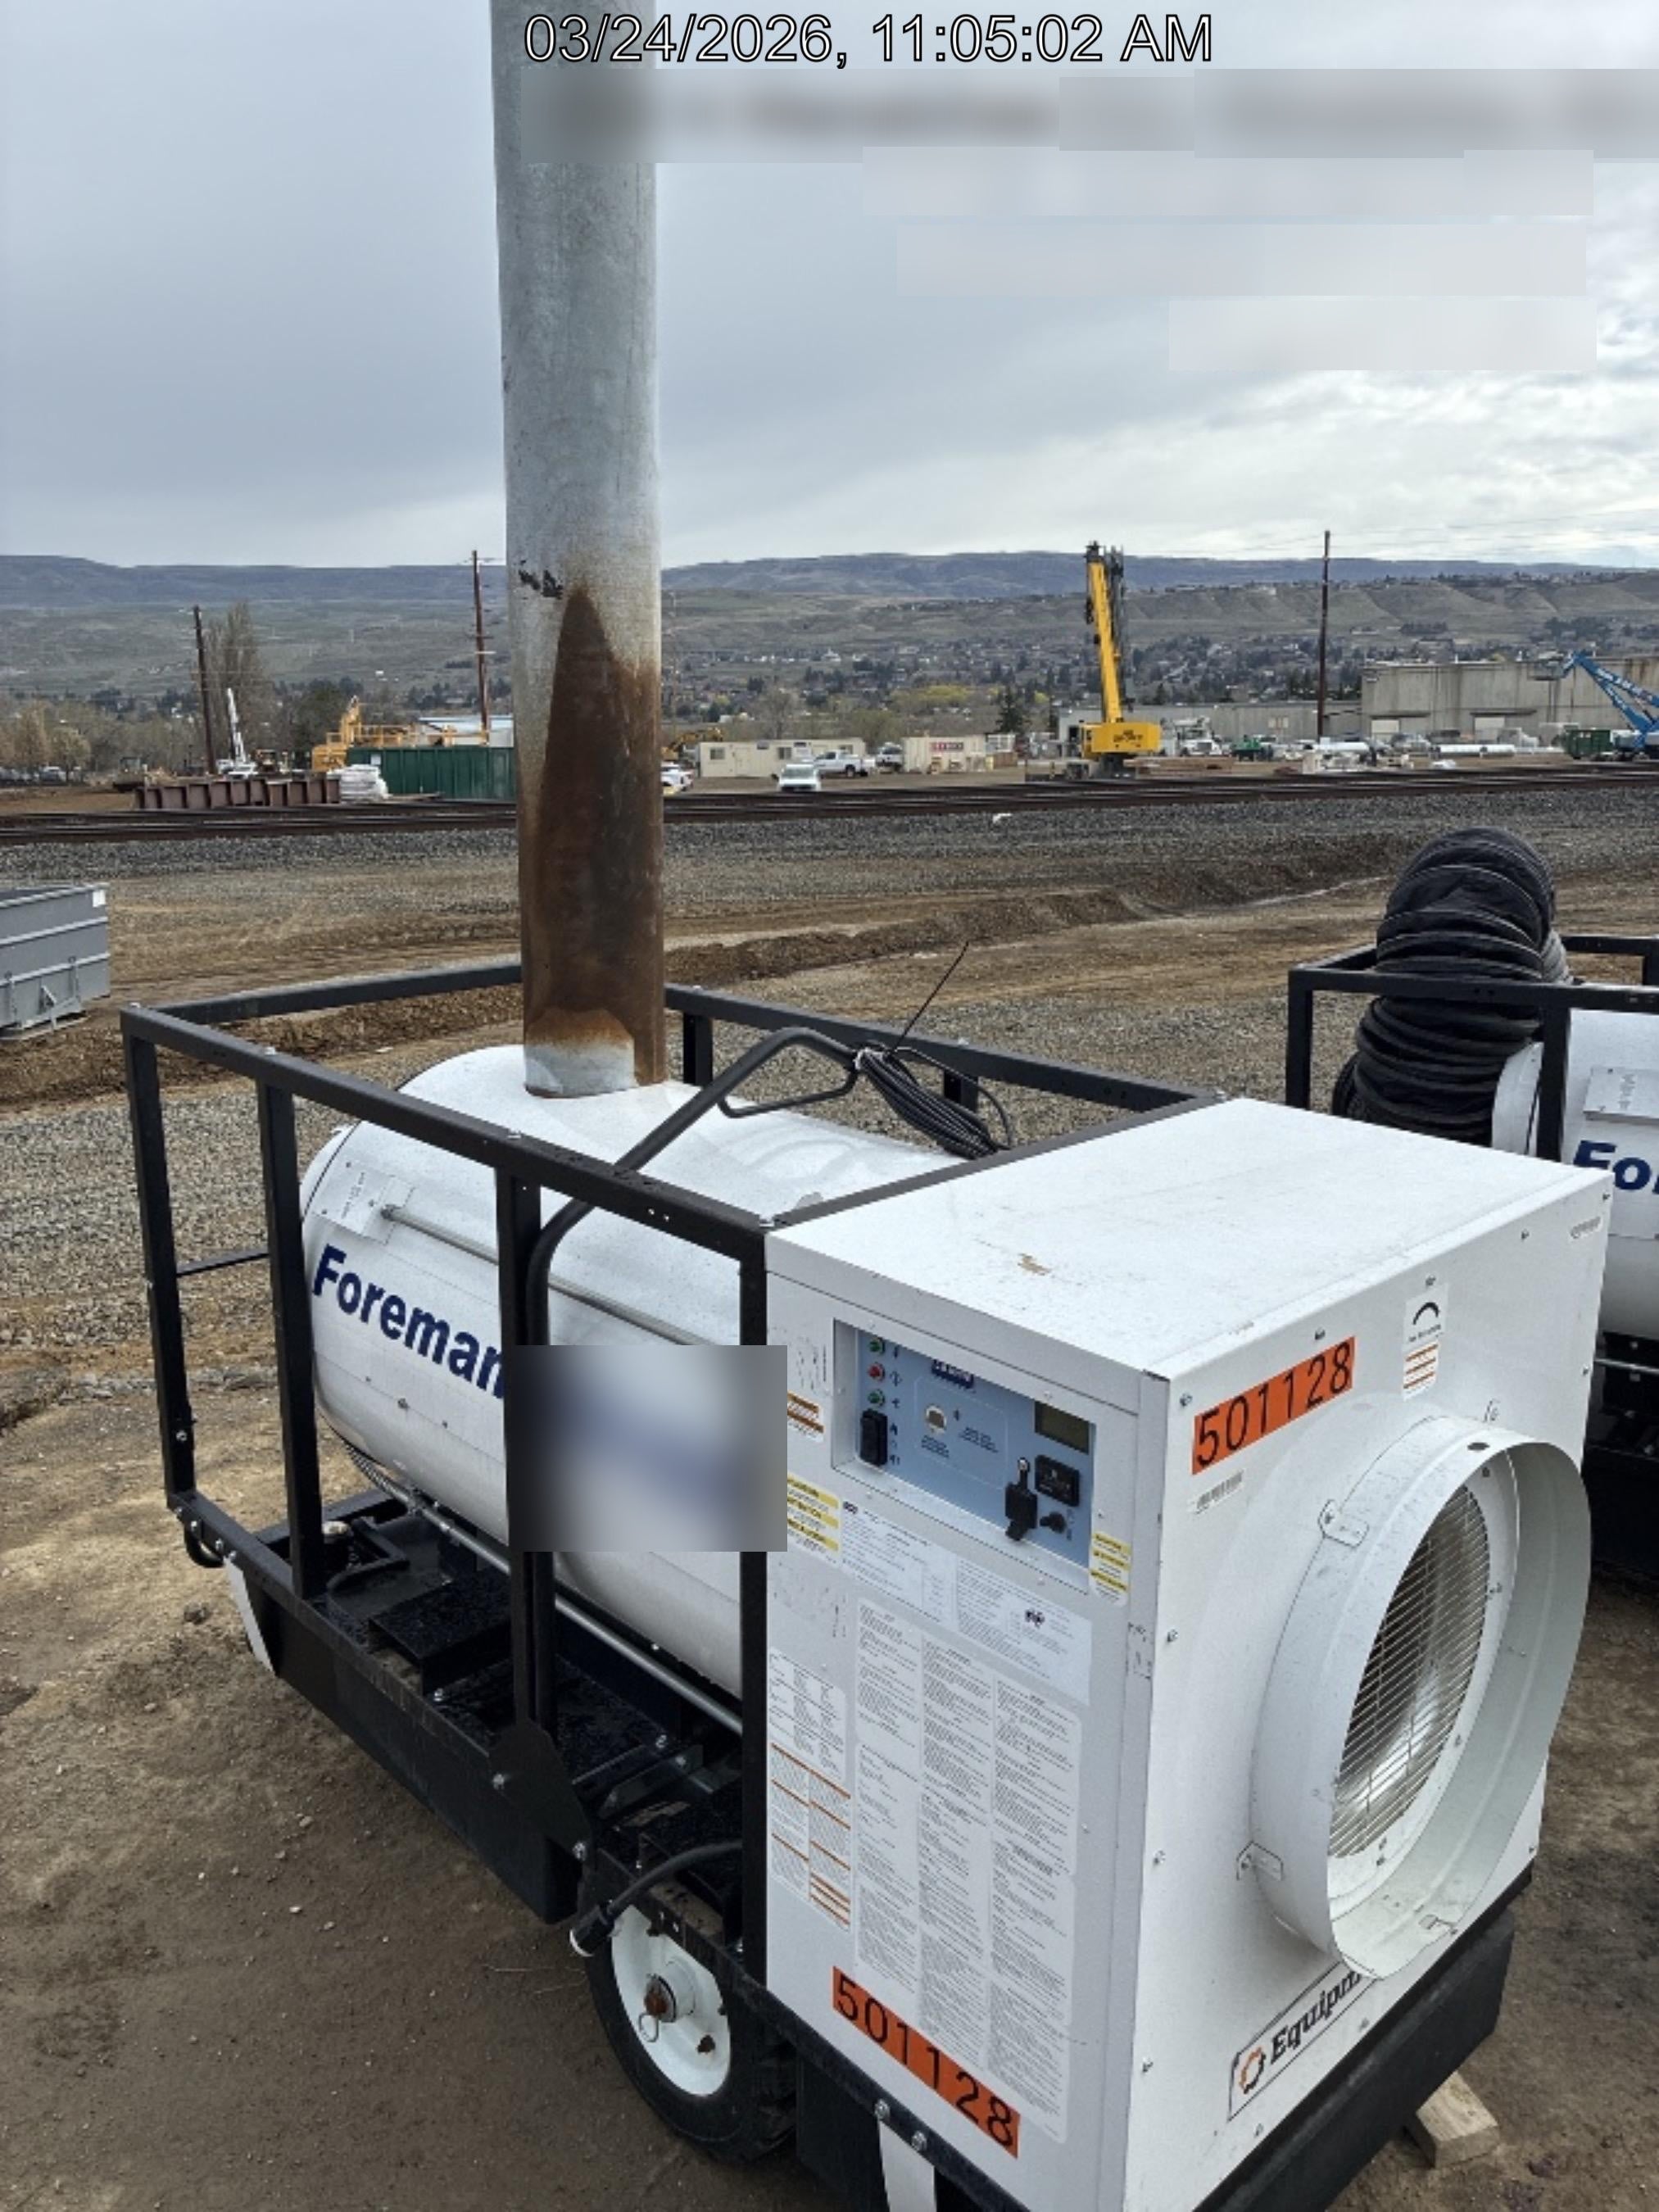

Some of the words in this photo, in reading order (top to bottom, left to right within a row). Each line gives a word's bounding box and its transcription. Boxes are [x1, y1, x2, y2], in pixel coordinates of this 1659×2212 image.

[1573, 1140, 1659, 1194] Fo
[1197, 1340, 1352, 1468] 501128
[838, 1973, 1013, 2146] 501128
